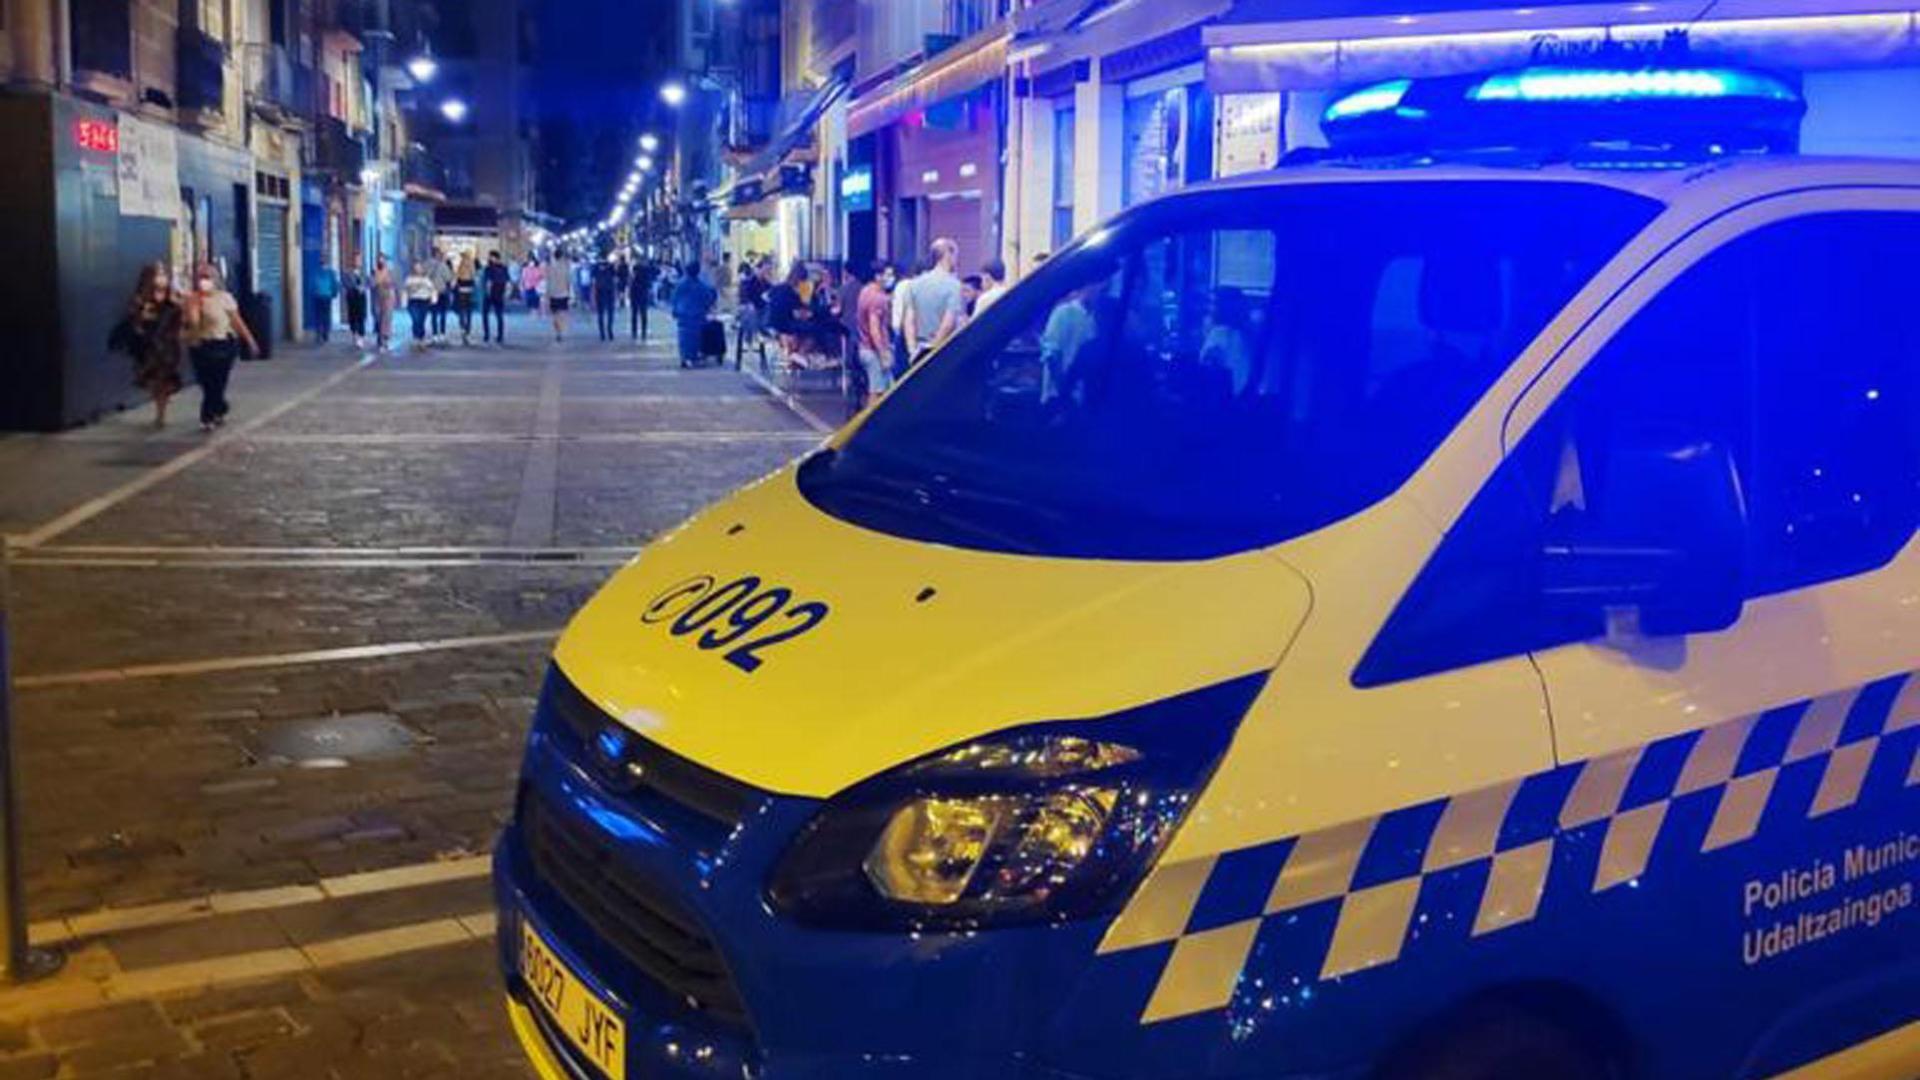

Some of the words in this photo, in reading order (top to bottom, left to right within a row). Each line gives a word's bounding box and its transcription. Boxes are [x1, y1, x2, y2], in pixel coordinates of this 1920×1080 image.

[670, 576, 829, 673] 092
[1743, 882, 1912, 965] Udaltzaingoa
[1744, 859, 1836, 917] Policia
[577, 1000, 618, 1068] JYF
